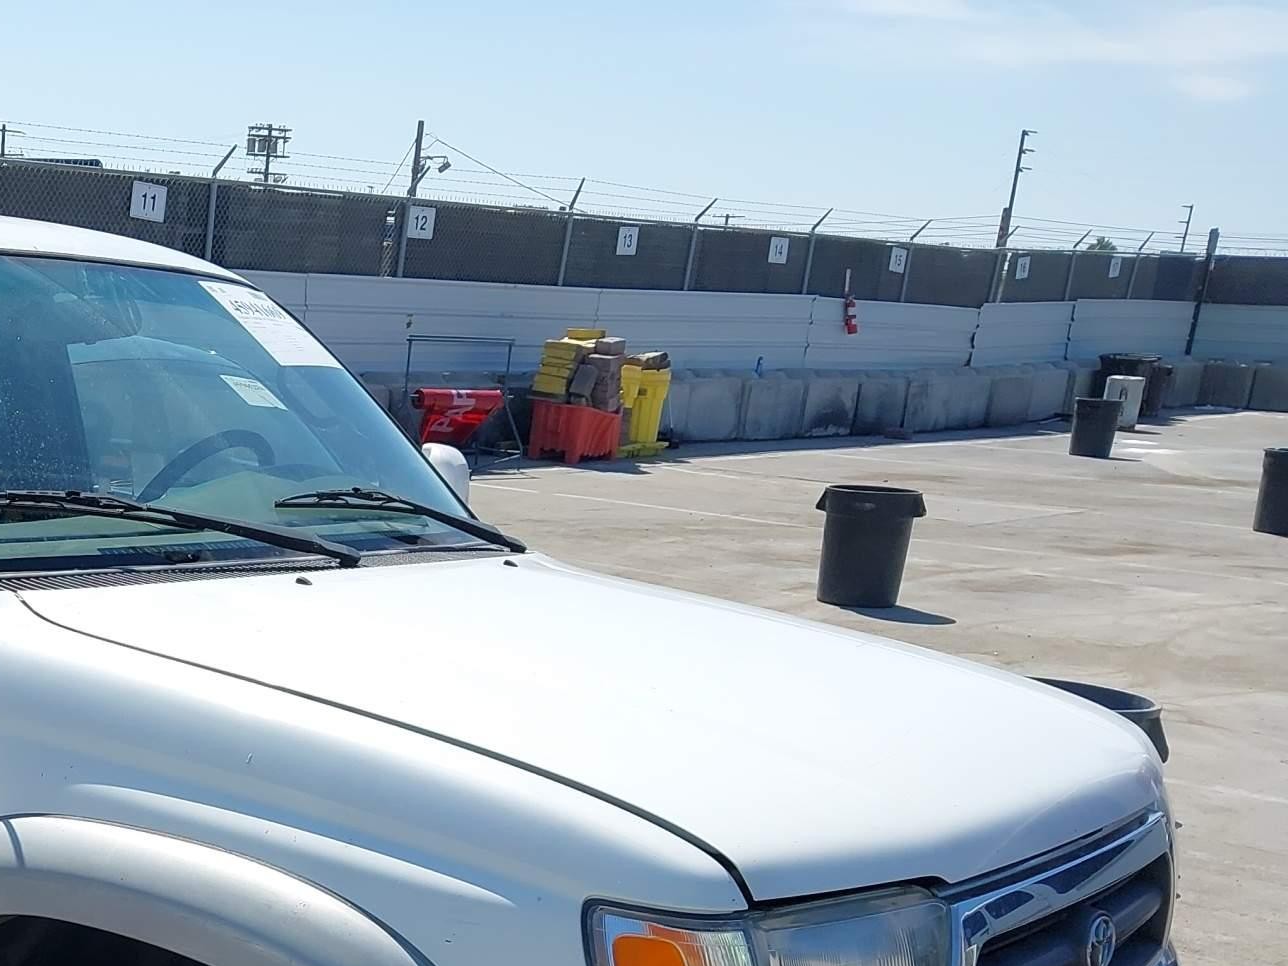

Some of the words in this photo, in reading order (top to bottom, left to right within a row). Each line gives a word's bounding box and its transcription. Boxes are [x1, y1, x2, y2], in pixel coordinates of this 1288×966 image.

[141, 191, 157, 212] 11
[414, 214, 428, 231] 12
[623, 232, 633, 248] 13
[774, 243, 783, 257] 14
[894, 254, 903, 267] 15
